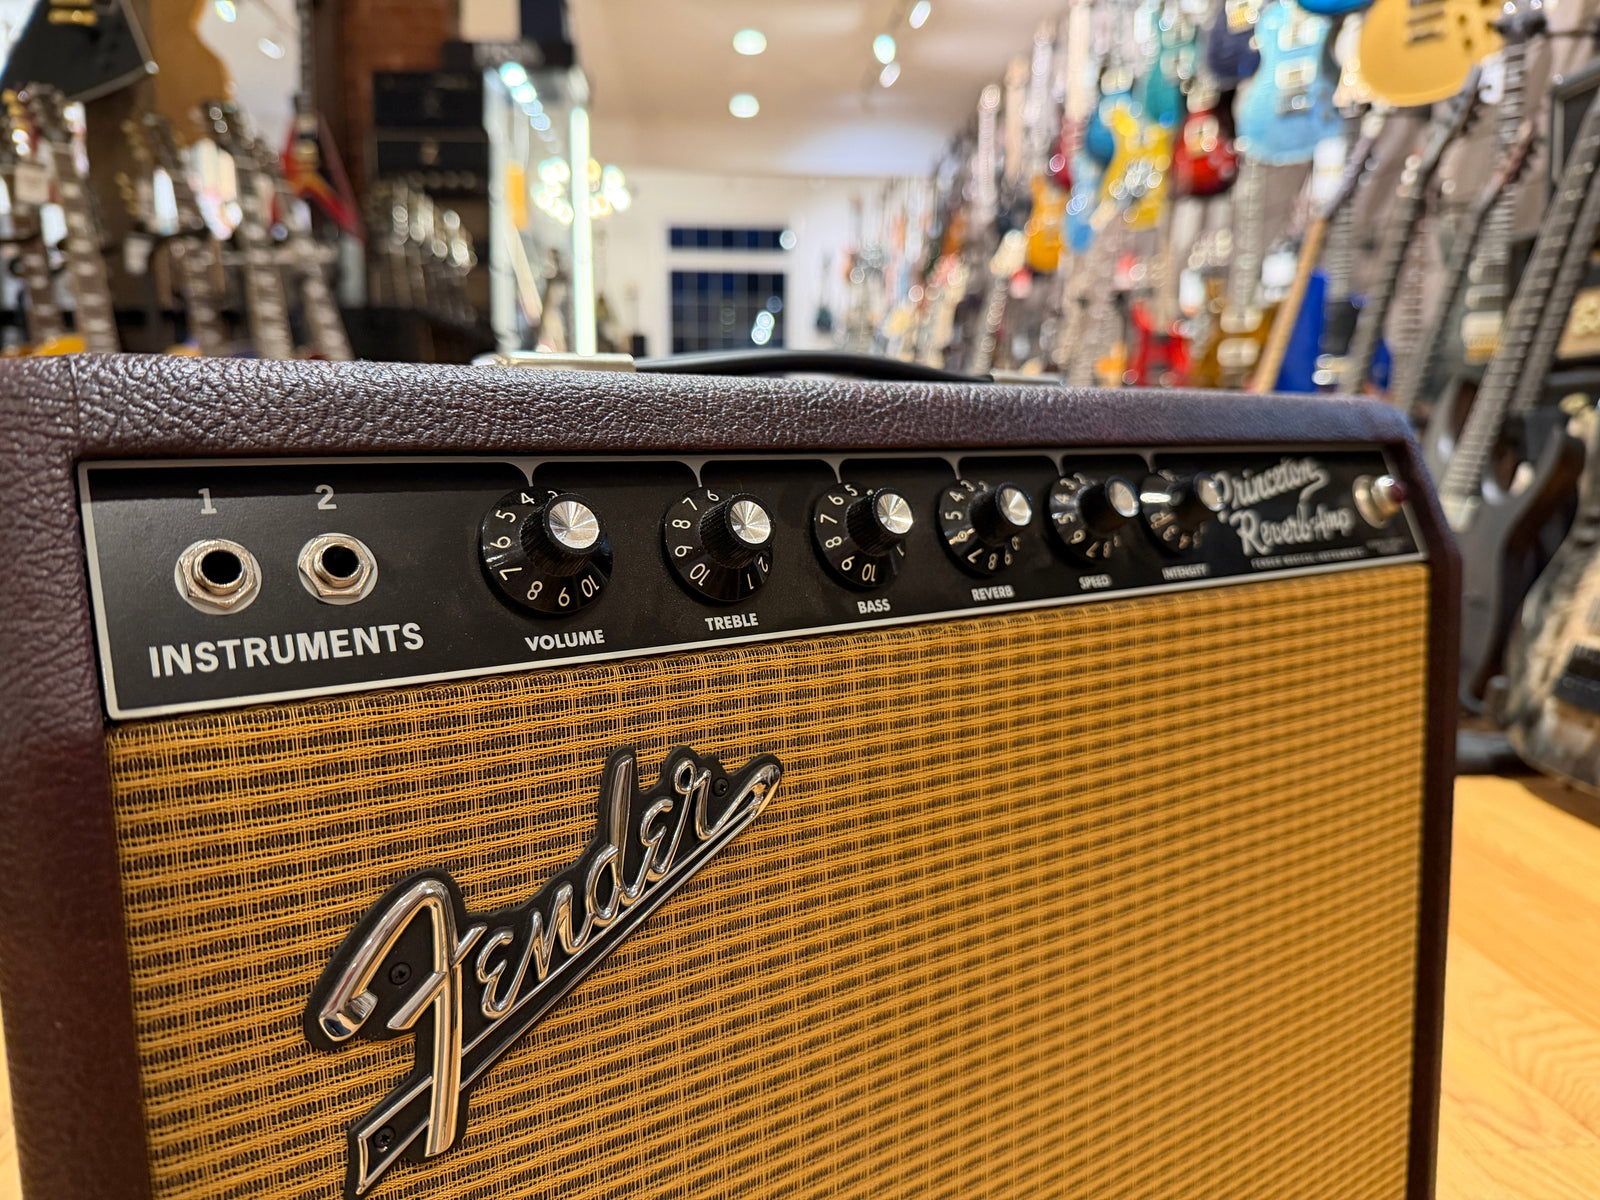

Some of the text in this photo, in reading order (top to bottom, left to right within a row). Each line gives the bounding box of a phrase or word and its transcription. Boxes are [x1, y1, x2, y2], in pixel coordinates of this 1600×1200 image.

[198, 487, 217, 514] 1
[314, 484, 338, 510] 2
[520, 492, 535, 505] 4
[682, 497, 698, 511] 7
[949, 491, 964, 502] 4
[495, 510, 517, 523] 5
[820, 513, 838, 524] 7
[945, 510, 963, 520] 5
[672, 519, 691, 529] 8
[490, 536, 511, 549] 6
[825, 536, 843, 548] 8
[499, 566, 523, 581] 7
[689, 563, 711, 587] 10
[861, 563, 876, 582] 10
[1162, 563, 1208, 580] INTENSITY
[581, 575, 600, 598] 10
[1079, 574, 1112, 590] SPEED
[526, 580, 543, 601] 8
[971, 585, 1015, 602] REVERB
[857, 598, 891, 614] BASS
[705, 612, 759, 631] TREBLE
[524, 629, 606, 652] VOLUME
[149, 622, 425, 678] INSTRUMENTS
[318, 756, 783, 1158] Fender
